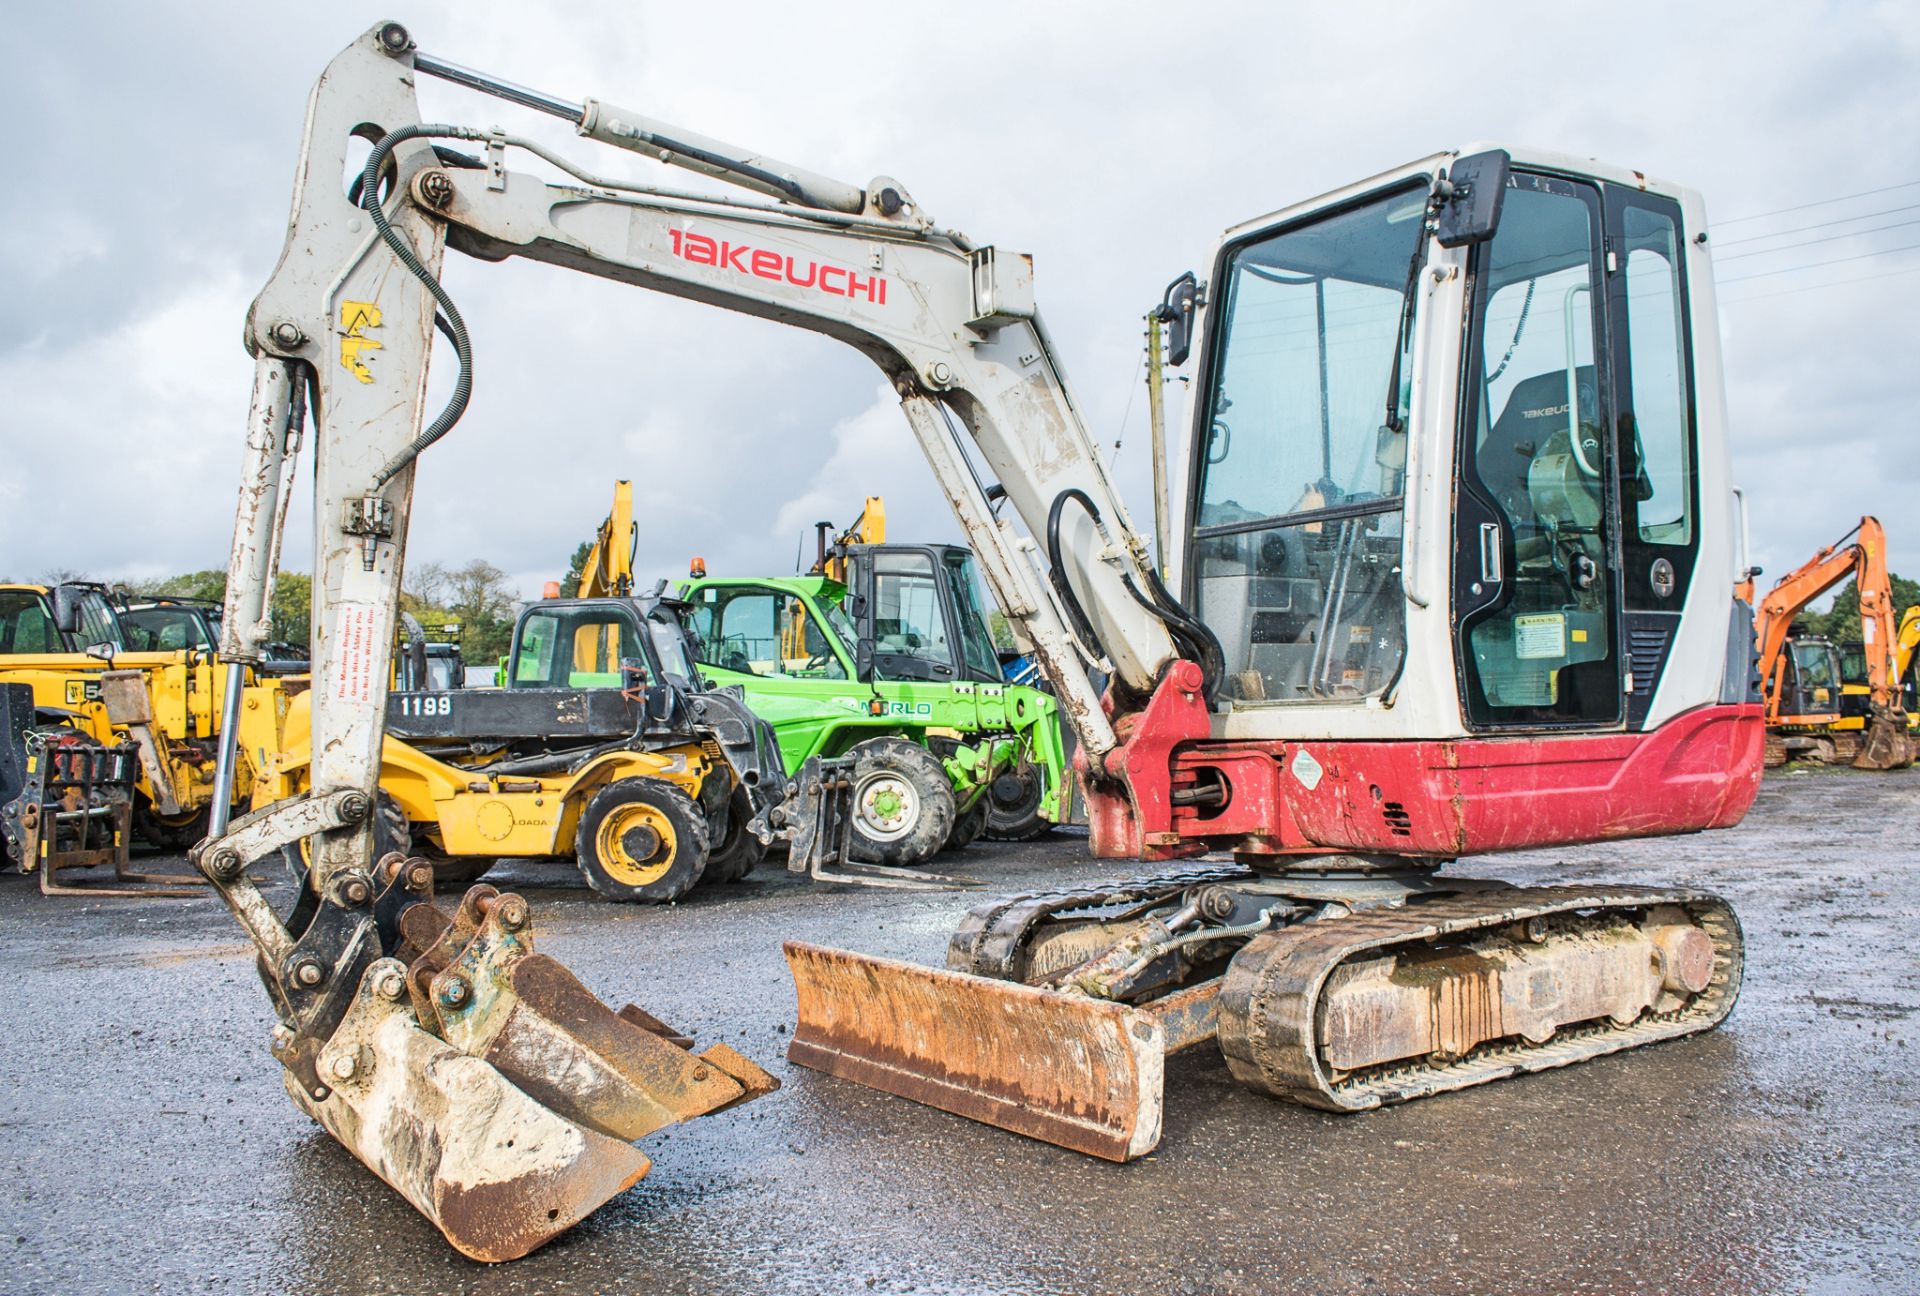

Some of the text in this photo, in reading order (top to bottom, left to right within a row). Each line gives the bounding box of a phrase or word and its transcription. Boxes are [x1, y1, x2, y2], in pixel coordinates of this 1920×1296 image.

[668, 228, 887, 305] TAKEUCHI
[343, 614, 351, 647] Requires
[340, 650, 348, 681] Machine
[362, 691, 368, 701] Do
[365, 626, 373, 655] Without
[401, 697, 451, 716] 1199
